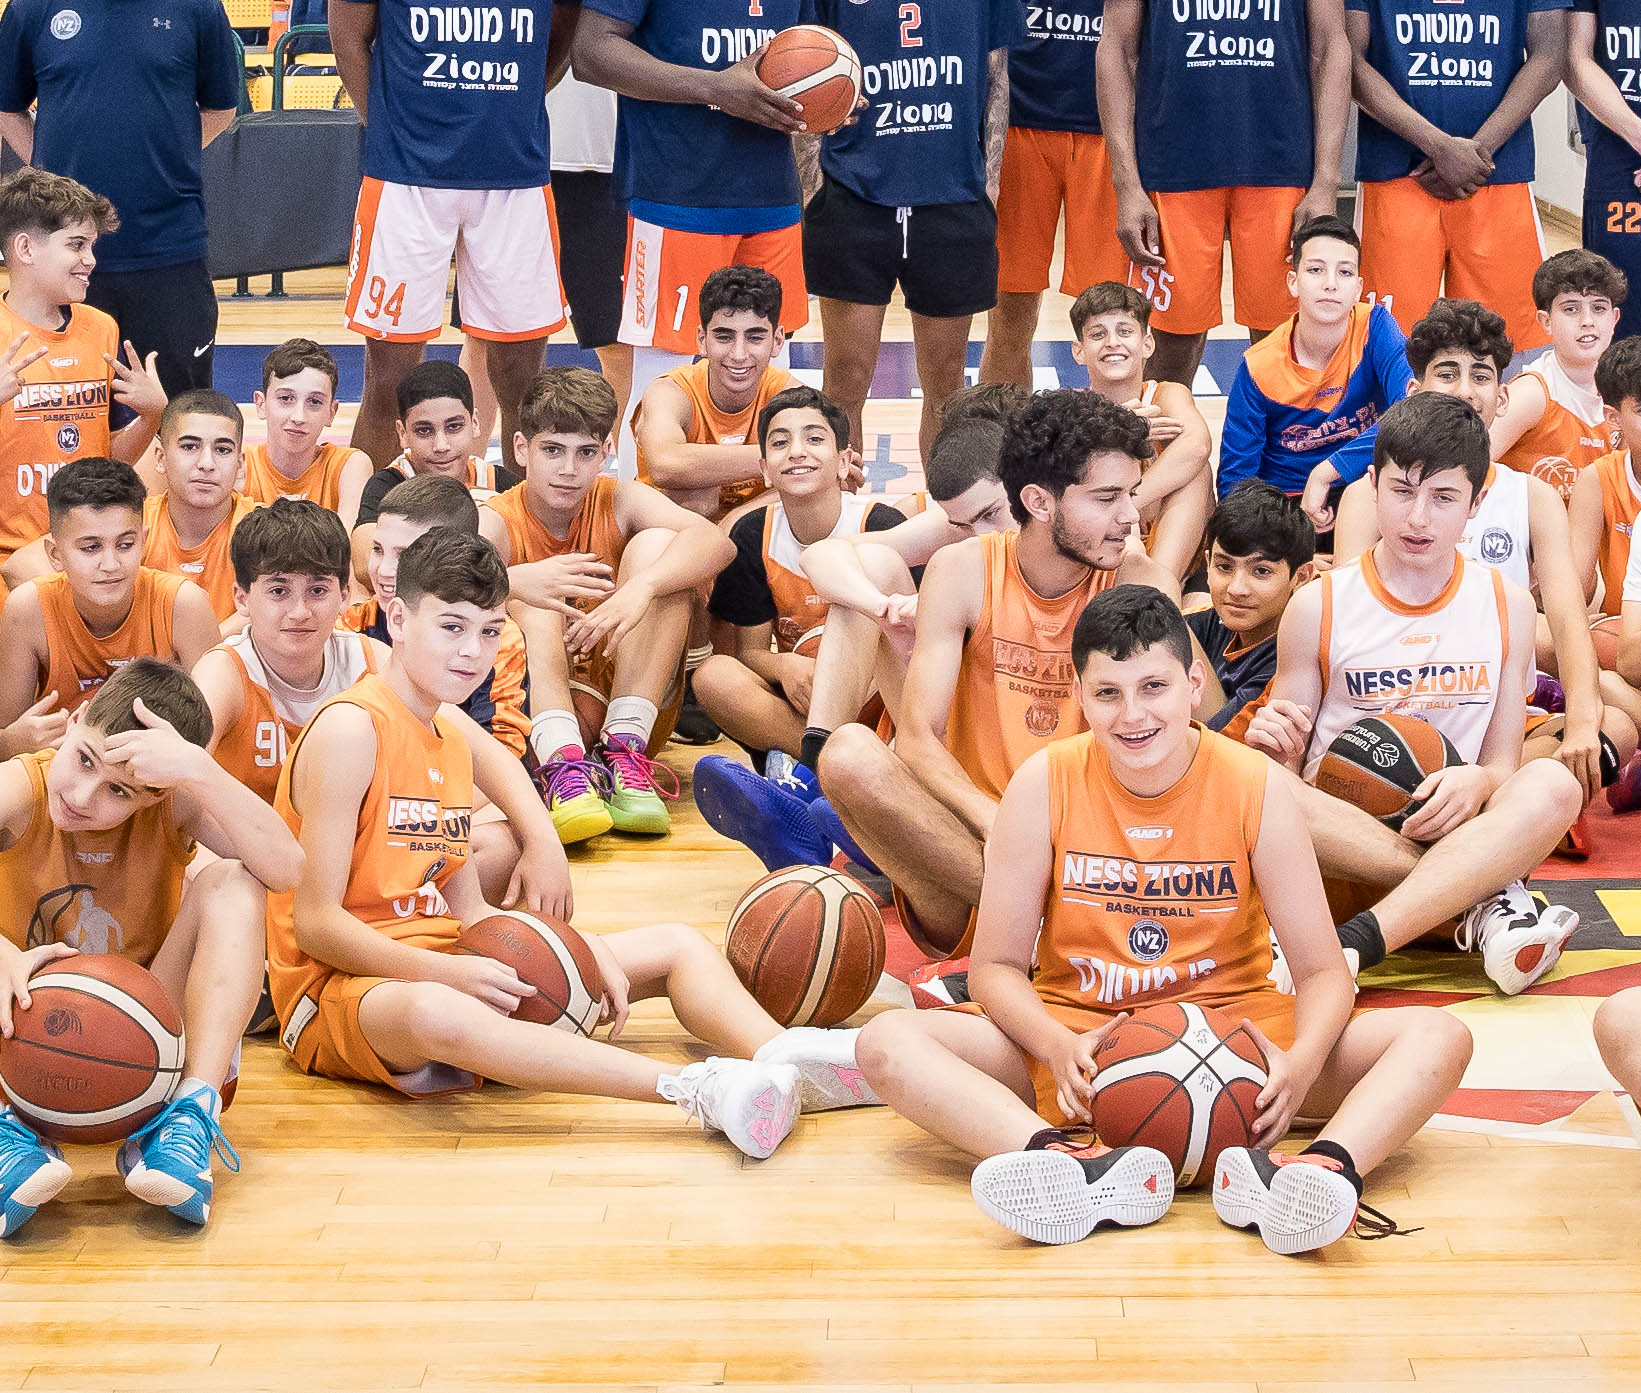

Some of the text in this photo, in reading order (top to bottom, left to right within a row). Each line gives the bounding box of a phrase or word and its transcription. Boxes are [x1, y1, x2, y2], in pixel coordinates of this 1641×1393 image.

[410, 6, 534, 44] חי מוטורס
[898, 3, 923, 48] 2
[1395, 12, 1500, 45] חי מוטורס
[1185, 31, 1275, 59] Ziona
[422, 53, 519, 84] Ziona
[863, 54, 963, 95] חי מוטורס
[1407, 52, 1493, 80] Ziona
[875, 99, 953, 130] Ziona
[1607, 201, 1641, 233] 22
[365, 275, 407, 327] 94
[672, 285, 689, 332] 1
[13, 383, 63, 409] NESS
[61, 431, 75, 446] NZ
[1483, 536, 1508, 553] NZ
[1008, 681, 1071, 699] BASKETBA
[1344, 664, 1491, 698] NESS ZIONA
[1062, 854, 1238, 897] NESS ZIONA
[1105, 901, 1195, 918] BASKETBALL
[1137, 930, 1160, 950] NZ
